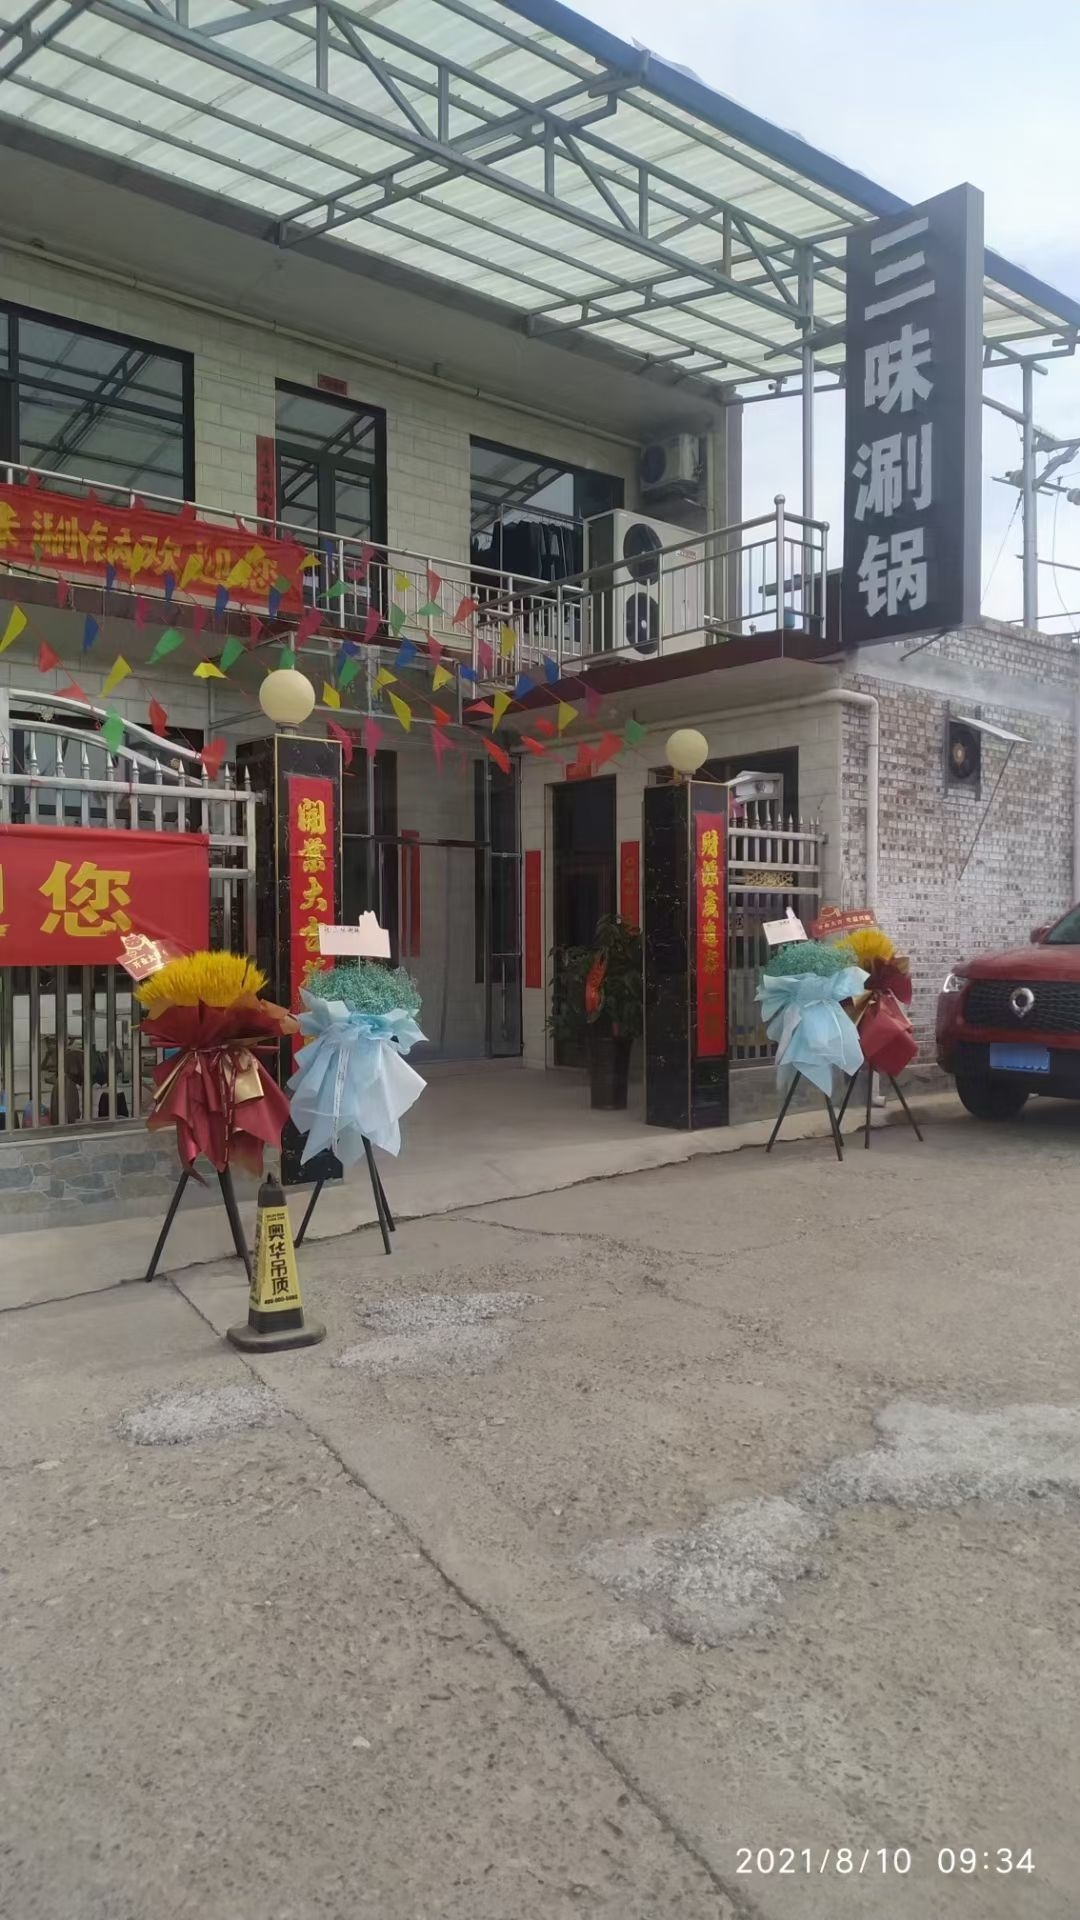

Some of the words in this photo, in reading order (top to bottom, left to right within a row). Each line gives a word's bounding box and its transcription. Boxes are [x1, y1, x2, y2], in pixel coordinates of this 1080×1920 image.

[853, 216, 935, 618] 三味涮锅
[0, 860, 132, 937] 您
[268, 1223, 289, 1295] 奥华吊顶
